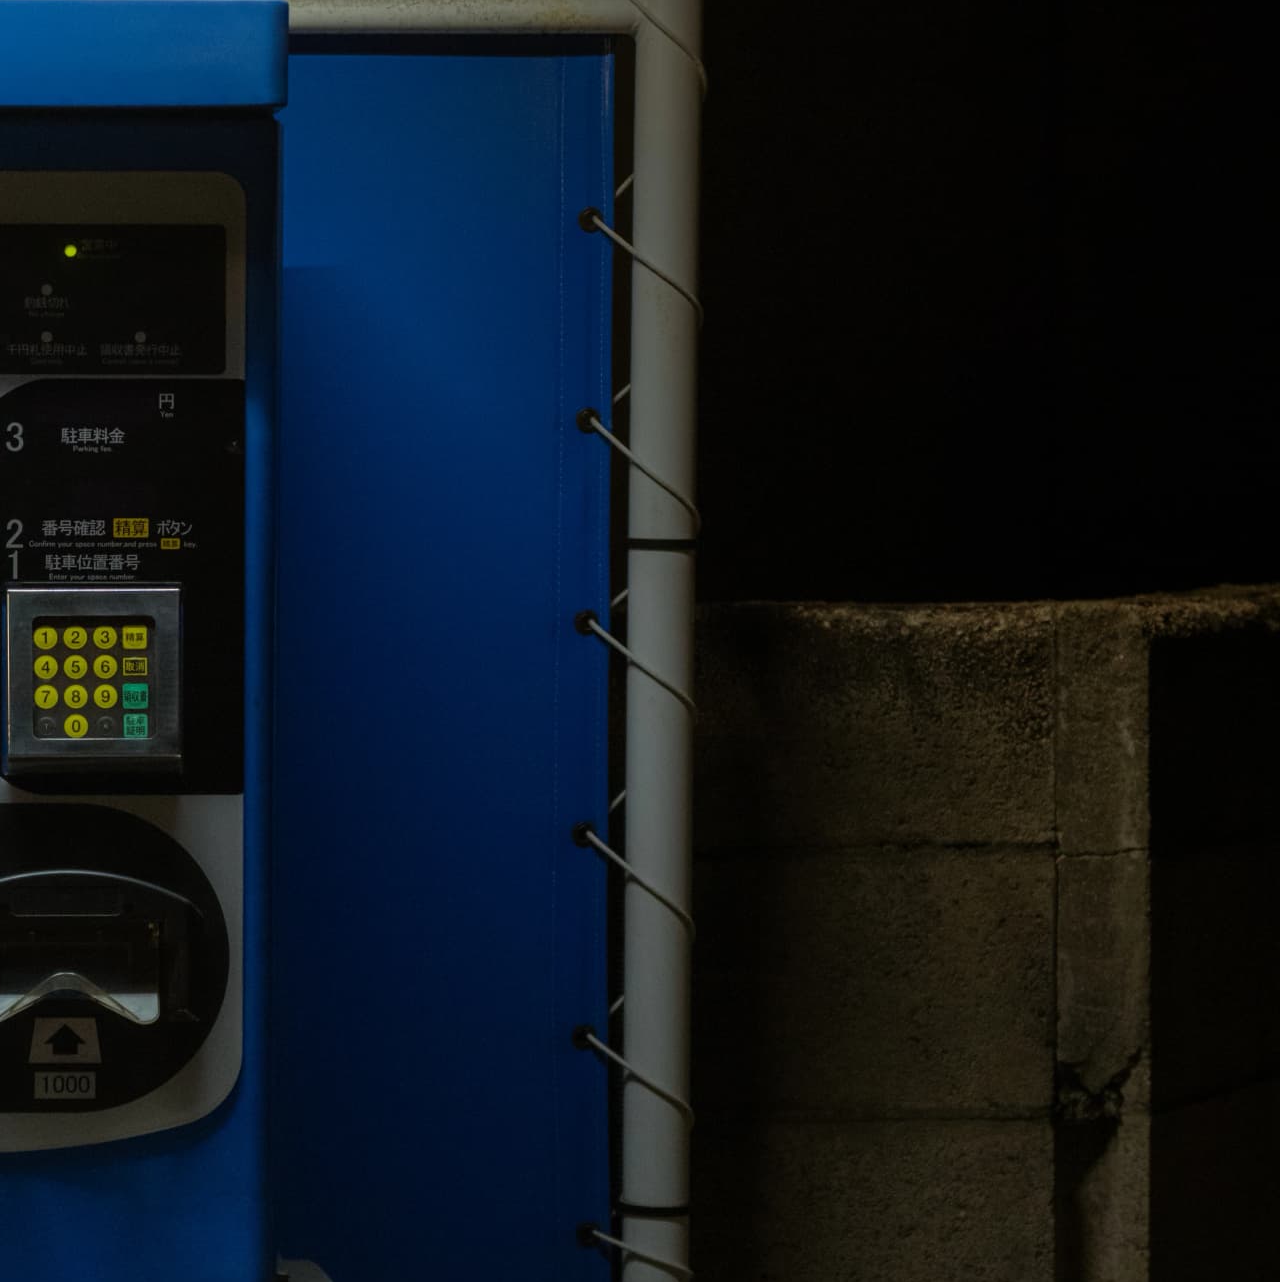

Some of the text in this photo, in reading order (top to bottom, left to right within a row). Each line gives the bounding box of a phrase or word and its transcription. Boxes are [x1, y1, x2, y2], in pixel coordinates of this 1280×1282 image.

[159, 392, 175, 410] 円
[6, 422, 24, 452] 3
[60, 427, 126, 445] 駐車料金
[6, 519, 24, 549] 2
[41, 520, 193, 537] 番号確認 精算 ボタン
[8, 550, 19, 579] 1
[44, 554, 141, 570] 駐車位置番号
[42, 631, 110, 644] 1 2 3
[41, 661, 110, 674] 4 5 6
[41, 690, 110, 703] 7 8 9
[72, 720, 80, 733] 0
[44, 1076, 90, 1094] 1000
